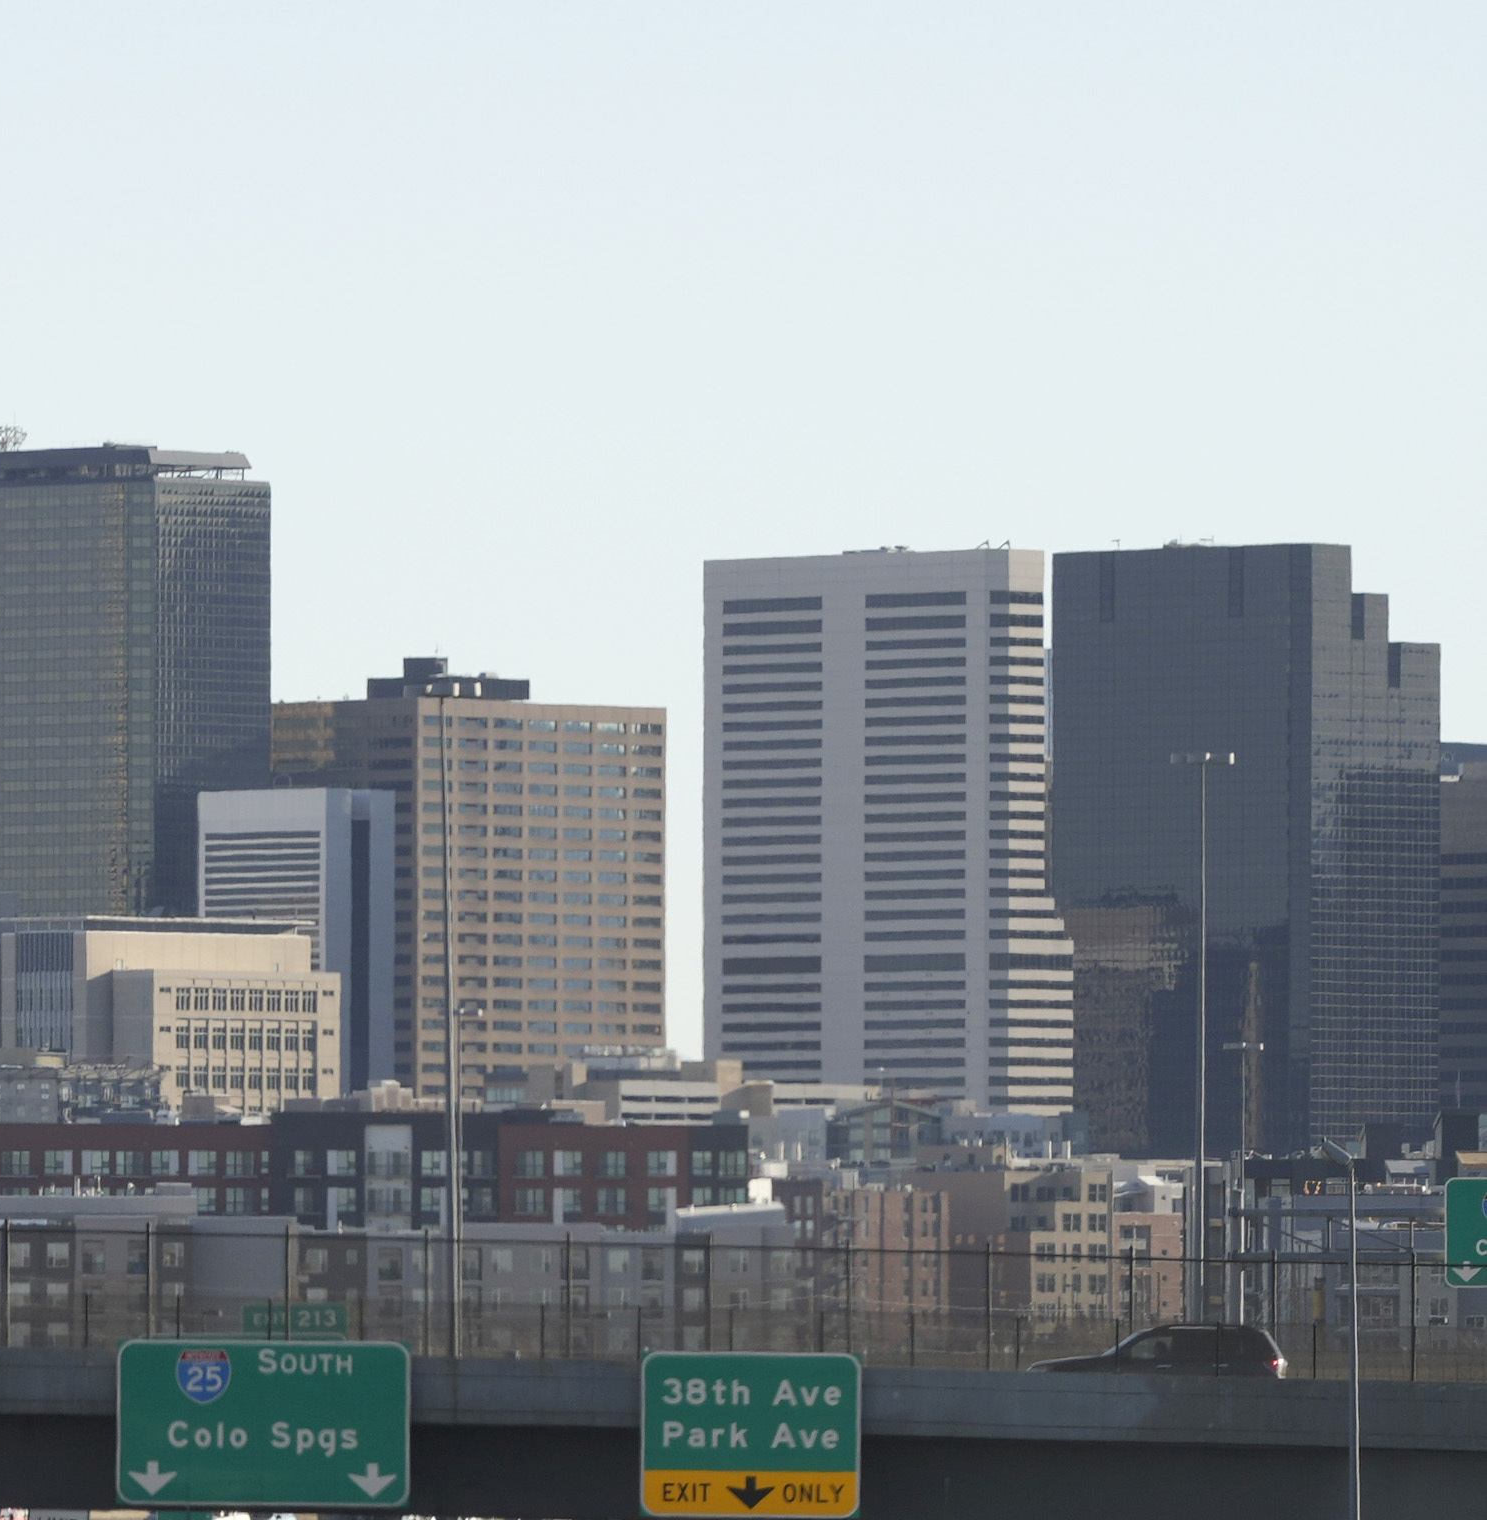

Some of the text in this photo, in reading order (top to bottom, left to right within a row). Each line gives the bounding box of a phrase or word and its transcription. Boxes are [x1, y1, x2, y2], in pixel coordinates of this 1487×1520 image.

[299, 1309, 336, 1327] 213
[259, 1348, 352, 1374] SOUTH
[187, 1366, 222, 1391] 25
[663, 1378, 841, 1406] 38th Ave
[168, 1421, 358, 1457] Colo Spgs
[663, 1421, 839, 1448] Park Ave
[663, 1483, 843, 1503] EXIT ONLY
